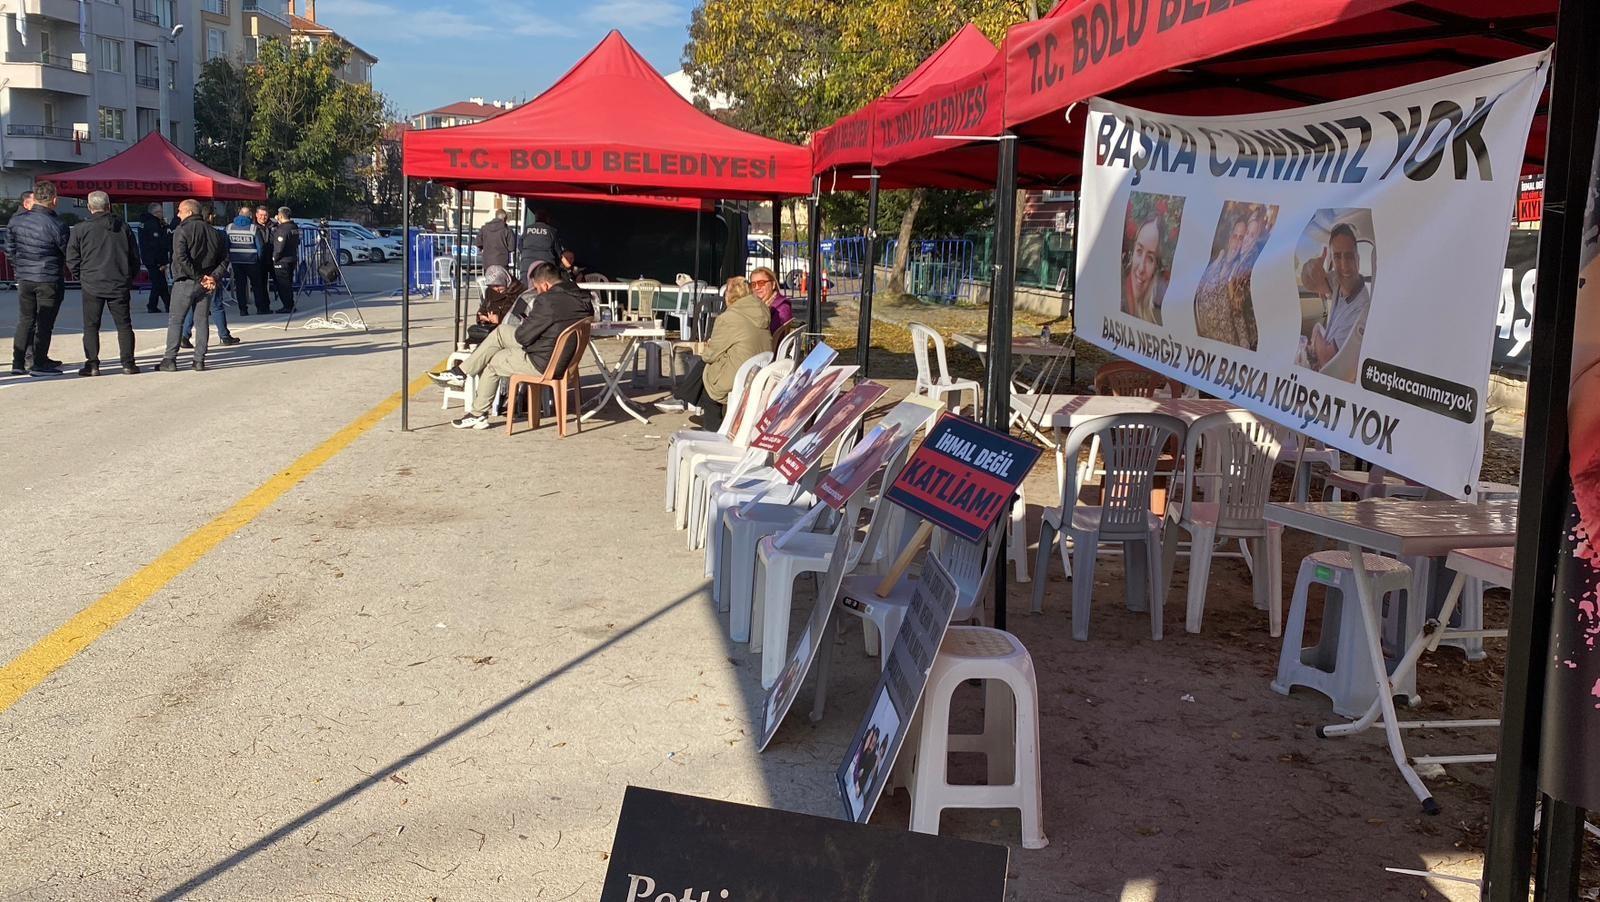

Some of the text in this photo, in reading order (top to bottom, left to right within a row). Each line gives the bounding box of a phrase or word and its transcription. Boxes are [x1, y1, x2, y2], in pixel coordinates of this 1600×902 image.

[1026, 33, 1064, 95] T.C.
[1071, 0, 1149, 75] BOLU
[443, 148, 776, 180] T.C. BOLU BELEDİYESİ
[1096, 94, 1499, 186] BAŞKA CANIMIZ YOK
[77, 180, 113, 190] BOLU
[1102, 316, 1400, 454] BAŞKA NERGİZ YOK BAŞKA KÜRŞAT YOK
[1365, 365, 1473, 413] #başkacanımızyok
[935, 428, 1014, 478] İHMAL DEĞİL
[901, 458, 1003, 521] KATLİAM!
